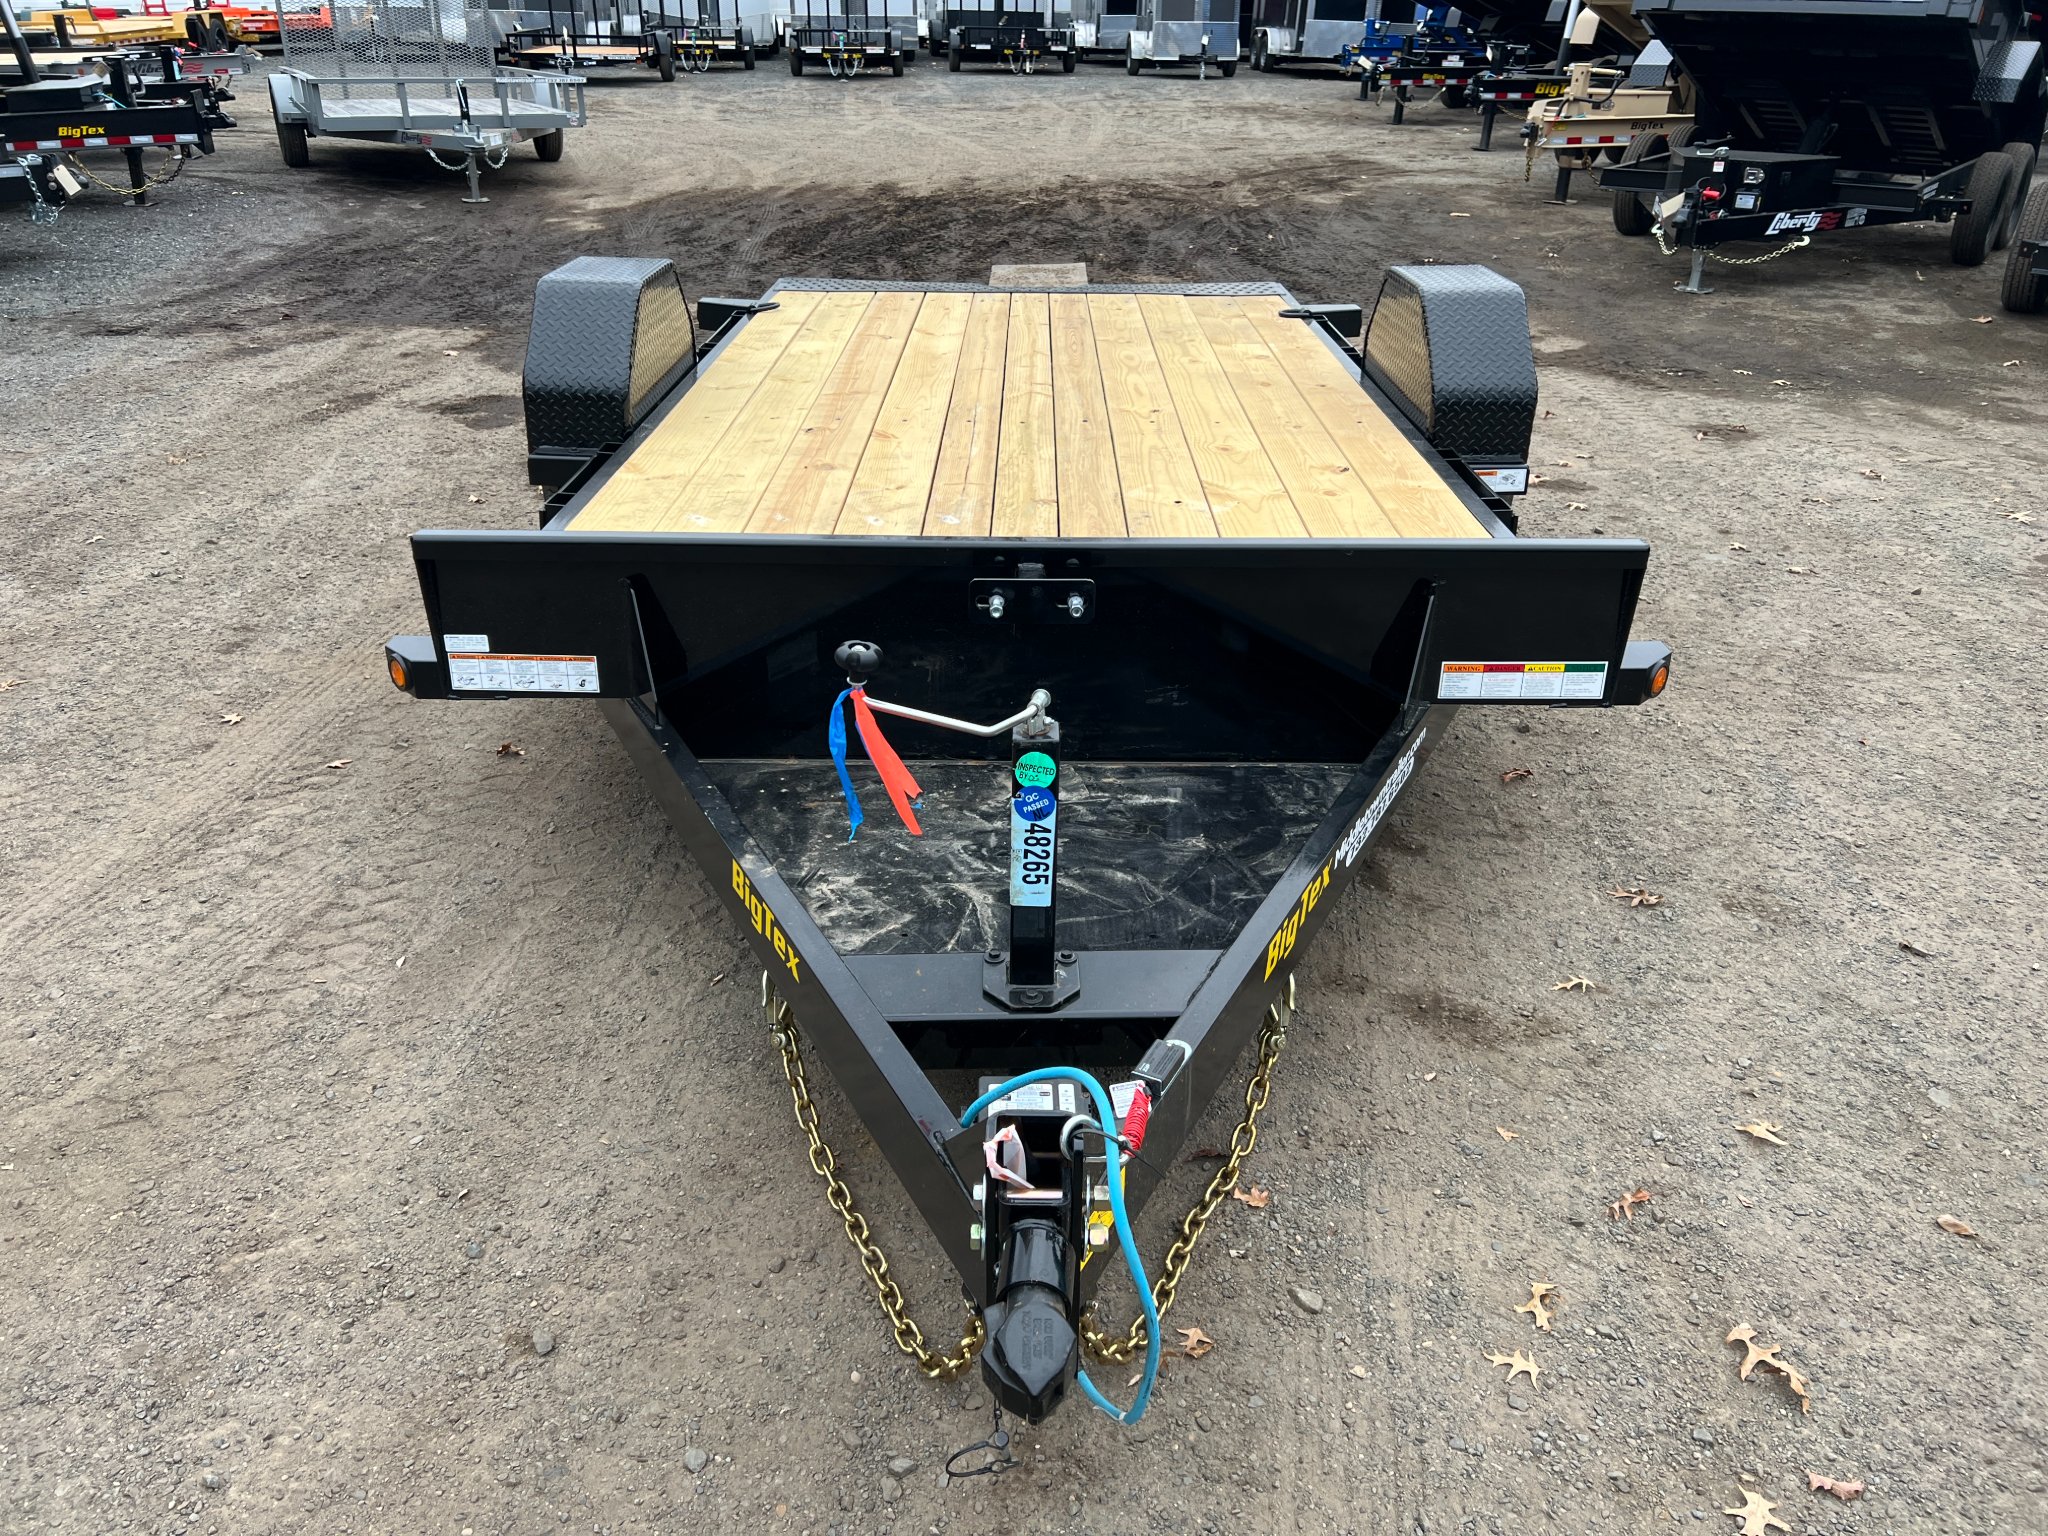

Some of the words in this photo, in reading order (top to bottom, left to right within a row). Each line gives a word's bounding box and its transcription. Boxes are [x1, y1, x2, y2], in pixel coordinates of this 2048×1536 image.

[1535, 82, 1568, 97] BigT
[58, 125, 105, 138] BigTex
[1631, 121, 1665, 131] BigTex
[1764, 211, 1823, 236] Liberty
[1017, 762, 1056, 776] INSPECTED
[1019, 771, 1029, 779] BY
[1025, 792, 1040, 803] QC
[1022, 798, 1050, 813] PASSED
[1022, 823, 1052, 885] 48265
[732, 858, 800, 984] BigTex
[1263, 856, 1334, 984] BigTex
